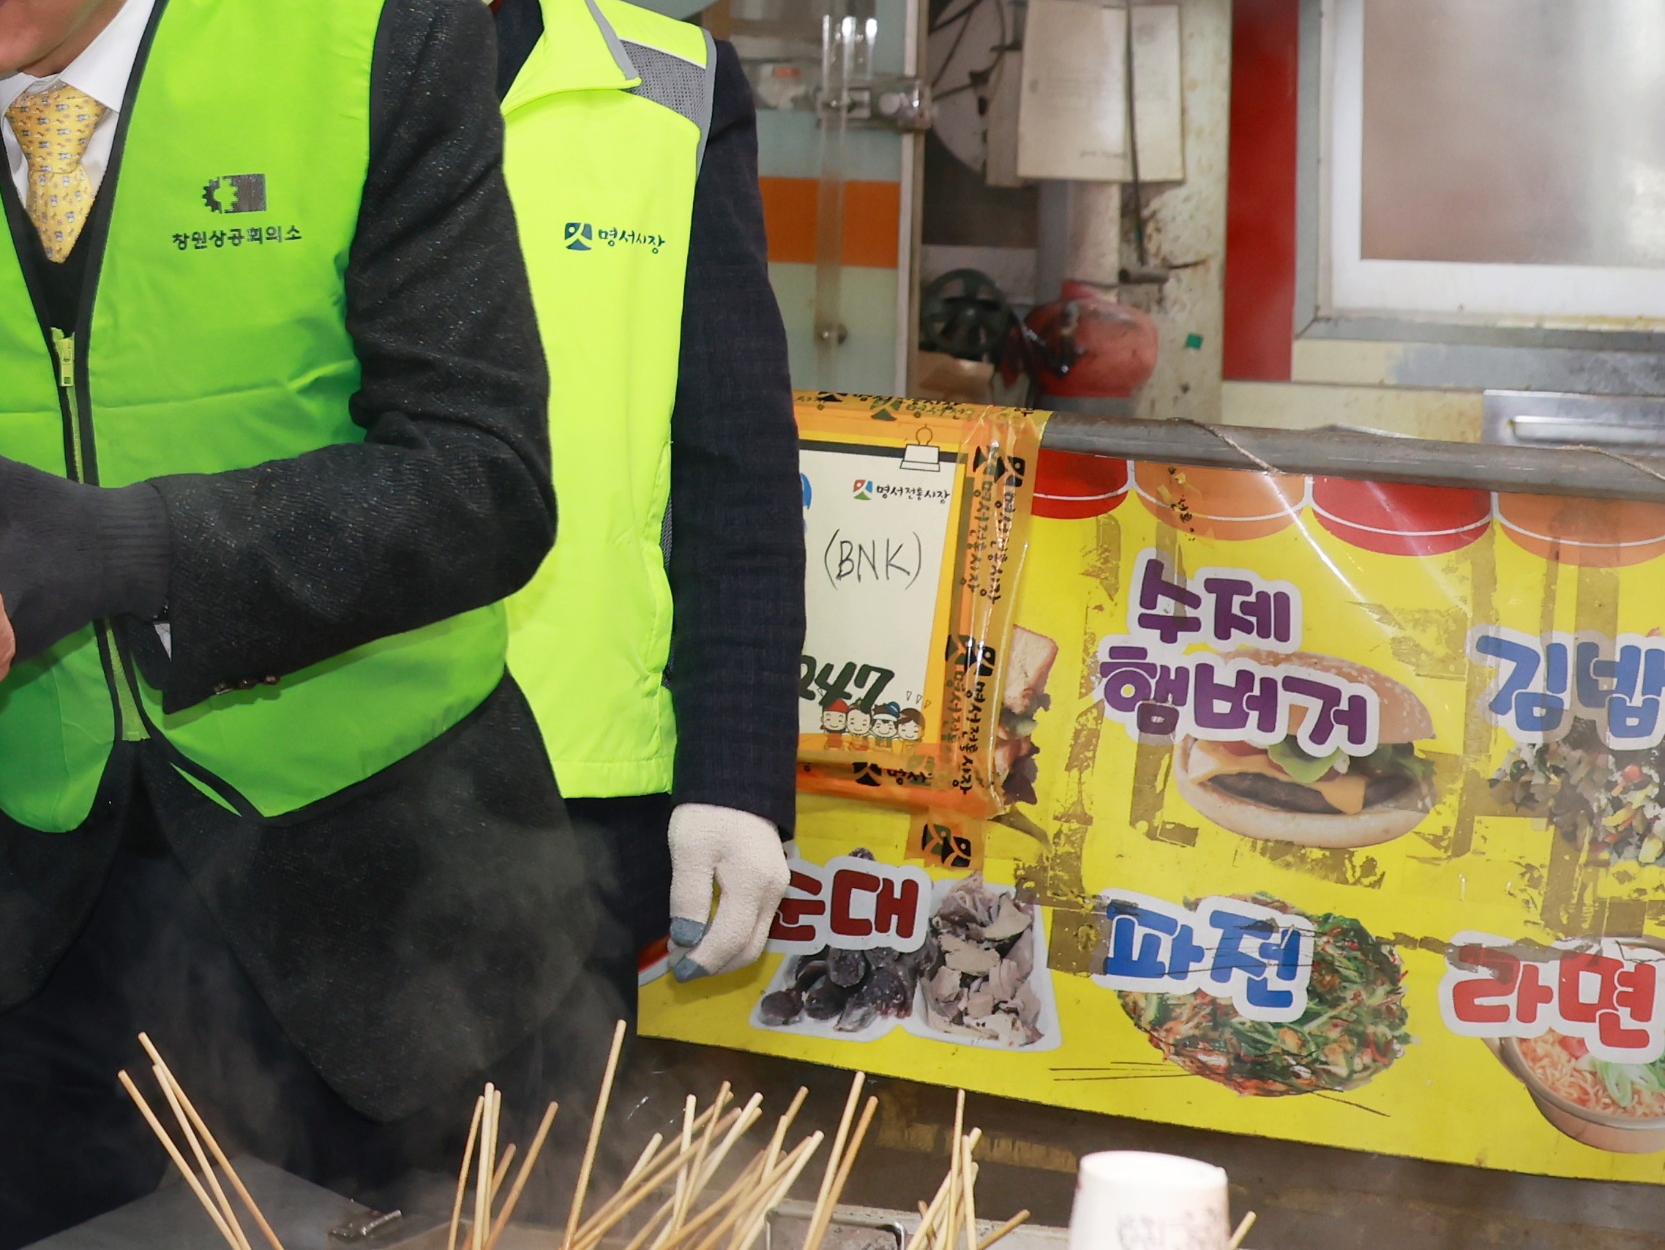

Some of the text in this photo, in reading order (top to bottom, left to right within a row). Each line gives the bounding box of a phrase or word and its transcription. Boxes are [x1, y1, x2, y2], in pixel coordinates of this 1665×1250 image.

[172, 225, 303, 250] 창원상공회의소
[597, 228, 666, 255] 명서시장
[875, 484, 950, 505] 명서전통시장
[824, 528, 922, 590] (BNK)
[1138, 558, 1291, 644] 수제
[1100, 646, 1368, 747] 햄버거
[1102, 901, 1302, 1008] 파전
[1452, 944, 1656, 1049] 라면
